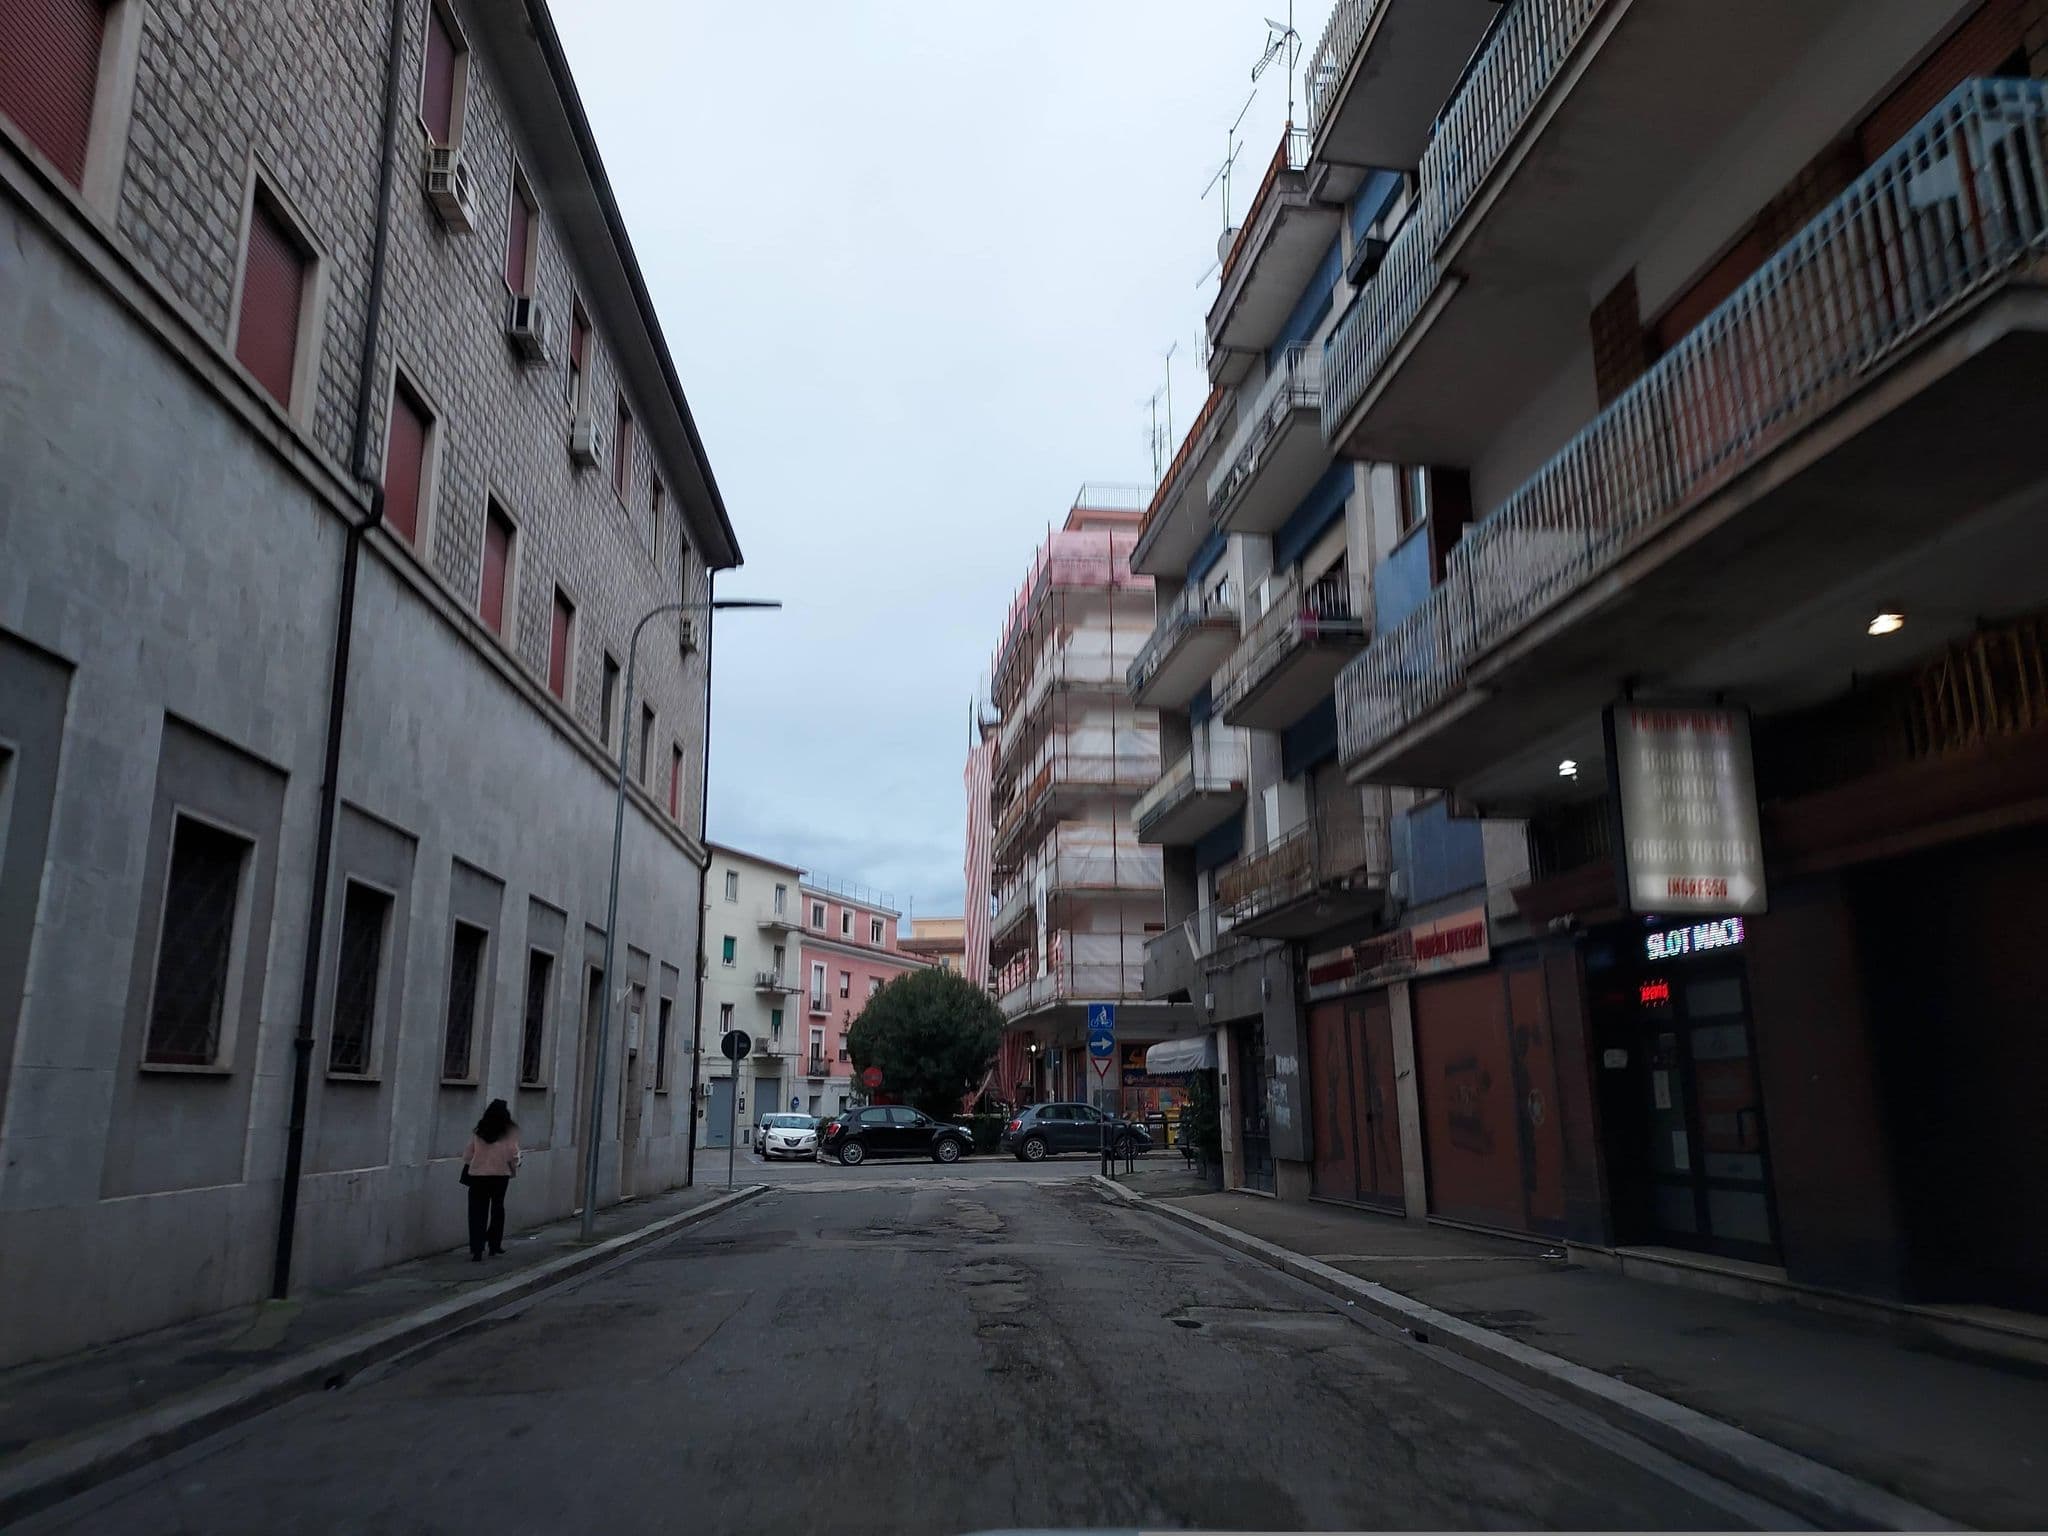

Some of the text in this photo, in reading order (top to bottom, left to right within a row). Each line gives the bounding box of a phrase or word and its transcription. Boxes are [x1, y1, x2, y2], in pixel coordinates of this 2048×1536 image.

[1632, 839, 1756, 865] GIOCHI VIRTUALI
[1667, 876, 1729, 898] INGRESSO
[1647, 927, 1691, 960] SLOT
